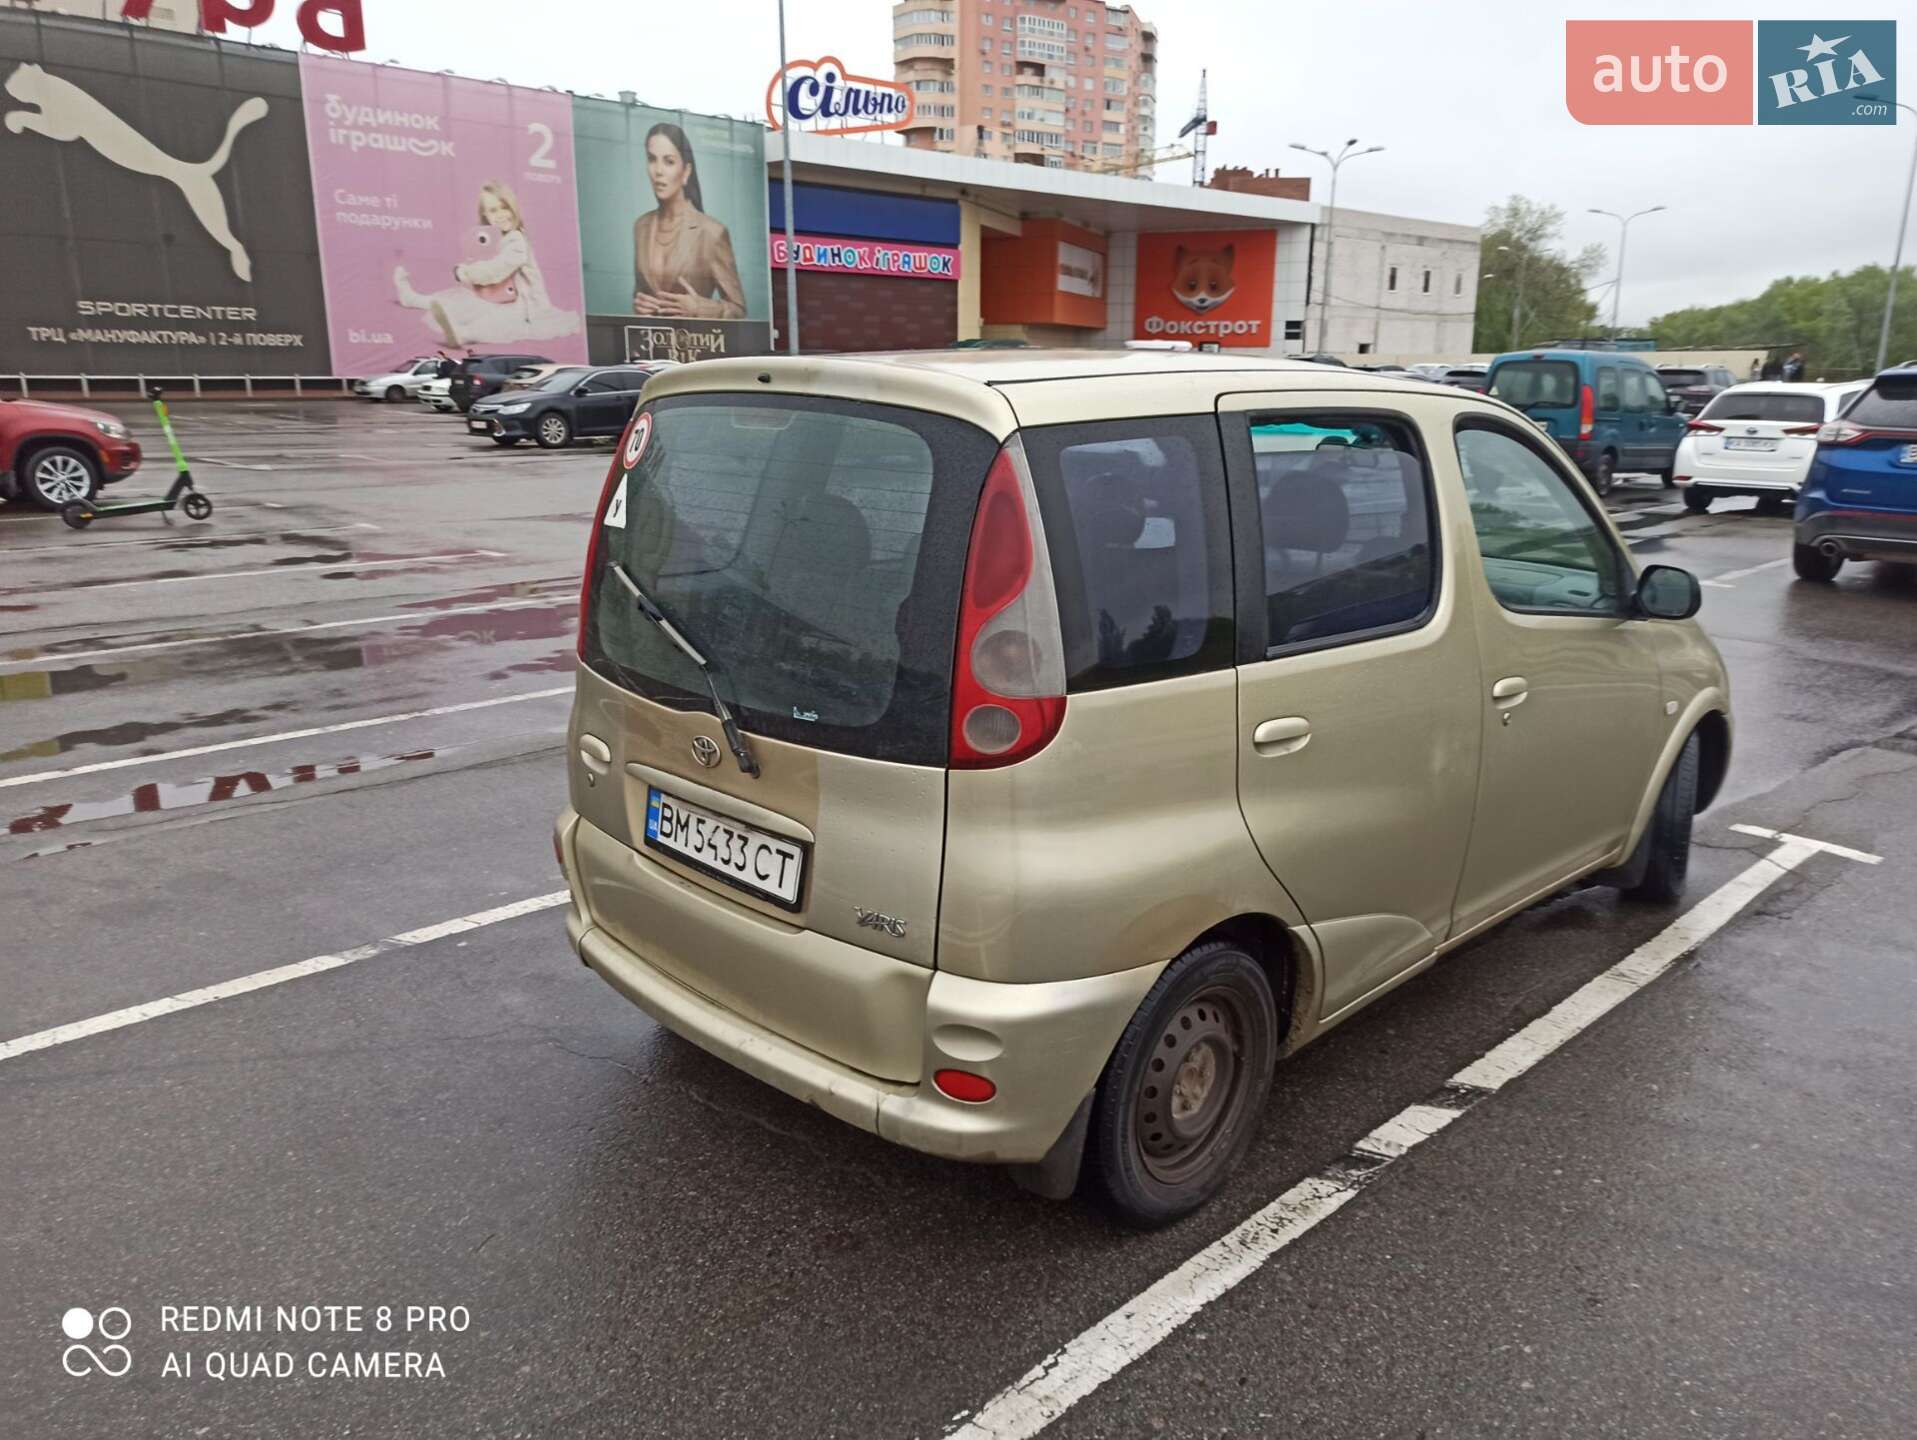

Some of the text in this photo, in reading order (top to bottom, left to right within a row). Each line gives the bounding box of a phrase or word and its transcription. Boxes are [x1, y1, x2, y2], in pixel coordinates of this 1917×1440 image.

[787, 71, 906, 121] Сільпо
[527, 121, 557, 169] 2
[77, 301, 257, 321] SPORTCENTER
[27, 326, 66, 344] ТРЦ
[1144, 316, 1261, 337] Фокстрот
[629, 427, 645, 453] 70
